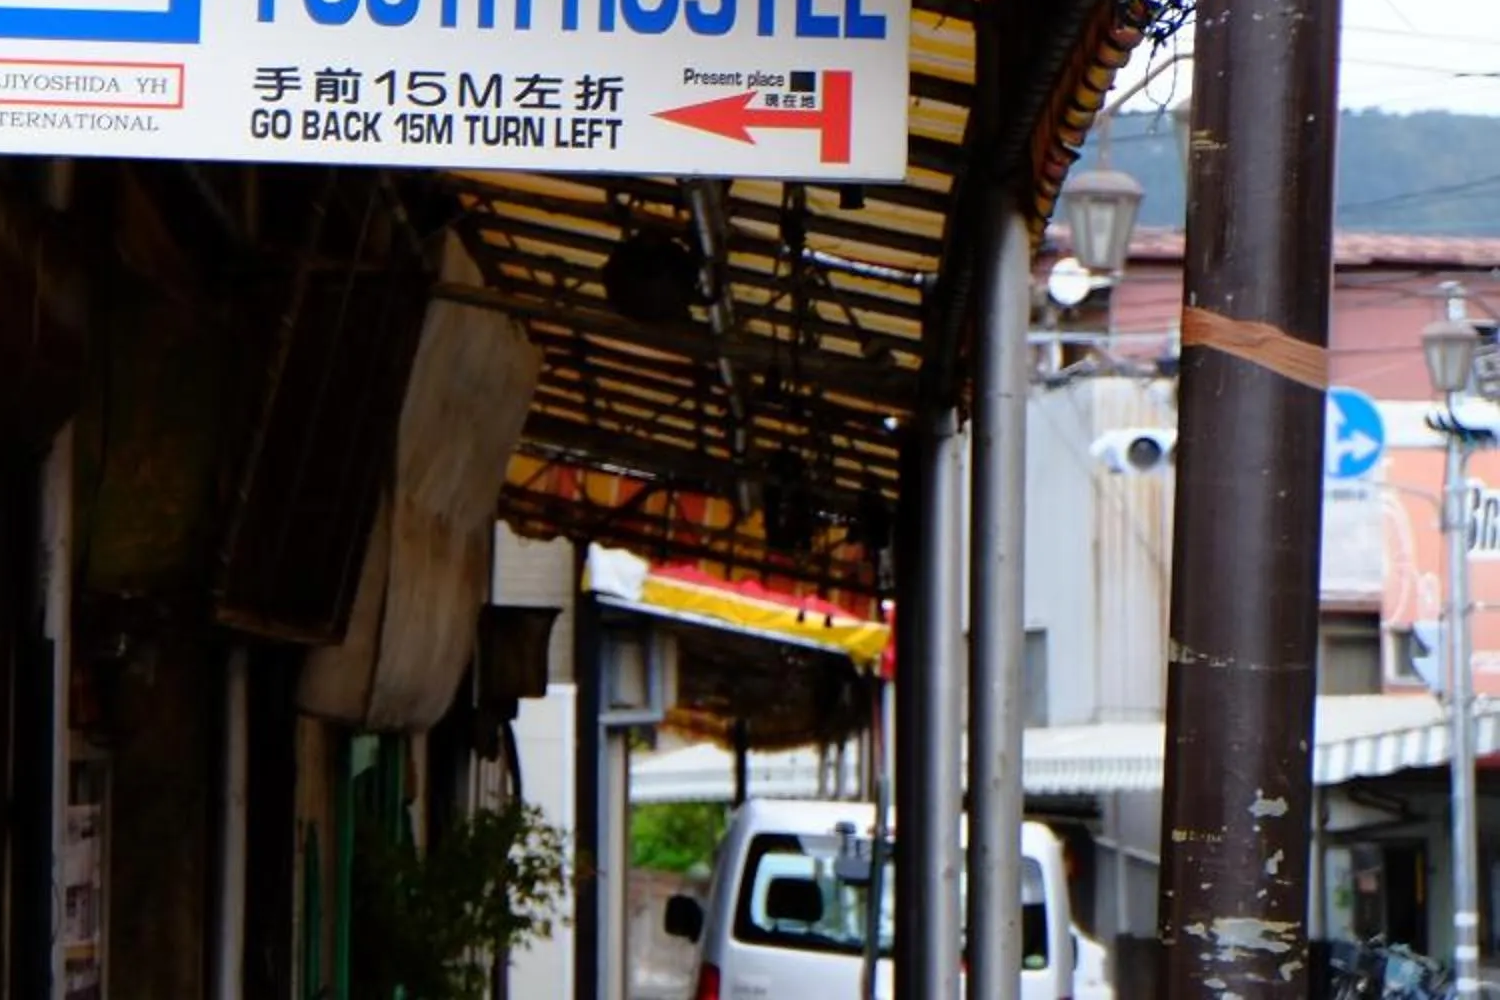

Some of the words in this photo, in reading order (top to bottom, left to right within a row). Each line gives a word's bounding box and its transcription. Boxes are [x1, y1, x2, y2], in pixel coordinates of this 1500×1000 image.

[137, 77, 168, 95] YH
[253, 66, 624, 112] 手前15M左折
[683, 68, 742, 86] Present
[747, 70, 785, 89] place
[765, 93, 816, 109] 現在地
[251, 109, 291, 140] GO
[301, 111, 382, 143] BACK
[394, 112, 452, 145] 15M
[464, 115, 545, 147] TURN
[554, 117, 623, 150] LEFT
